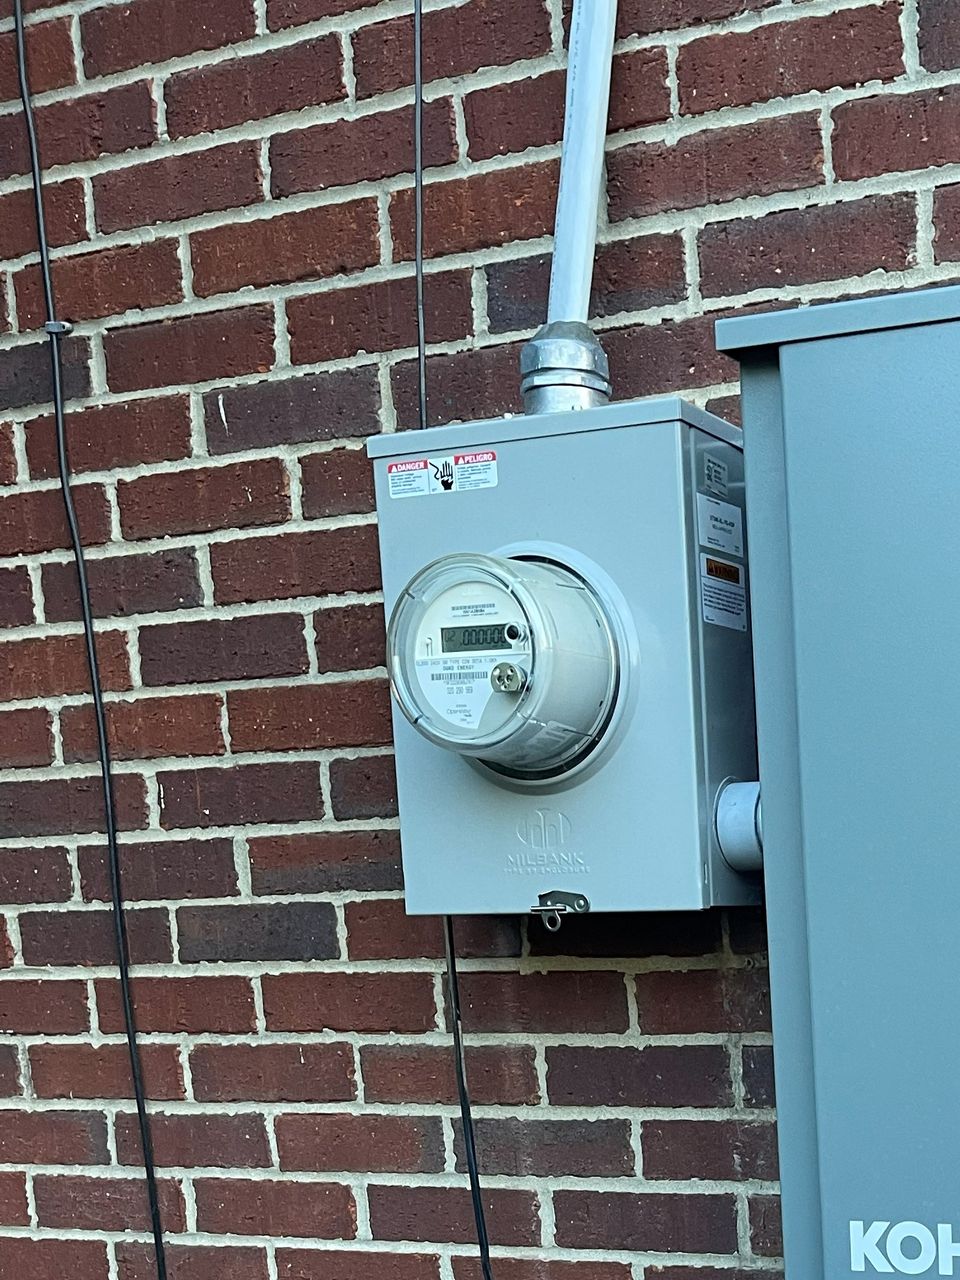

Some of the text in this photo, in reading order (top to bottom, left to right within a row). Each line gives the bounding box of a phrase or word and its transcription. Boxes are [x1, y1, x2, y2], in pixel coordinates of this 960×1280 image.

[464, 453, 493, 464] PELIGRO
[397, 461, 425, 472] DANGER
[505, 852, 584, 867] MILBANK
